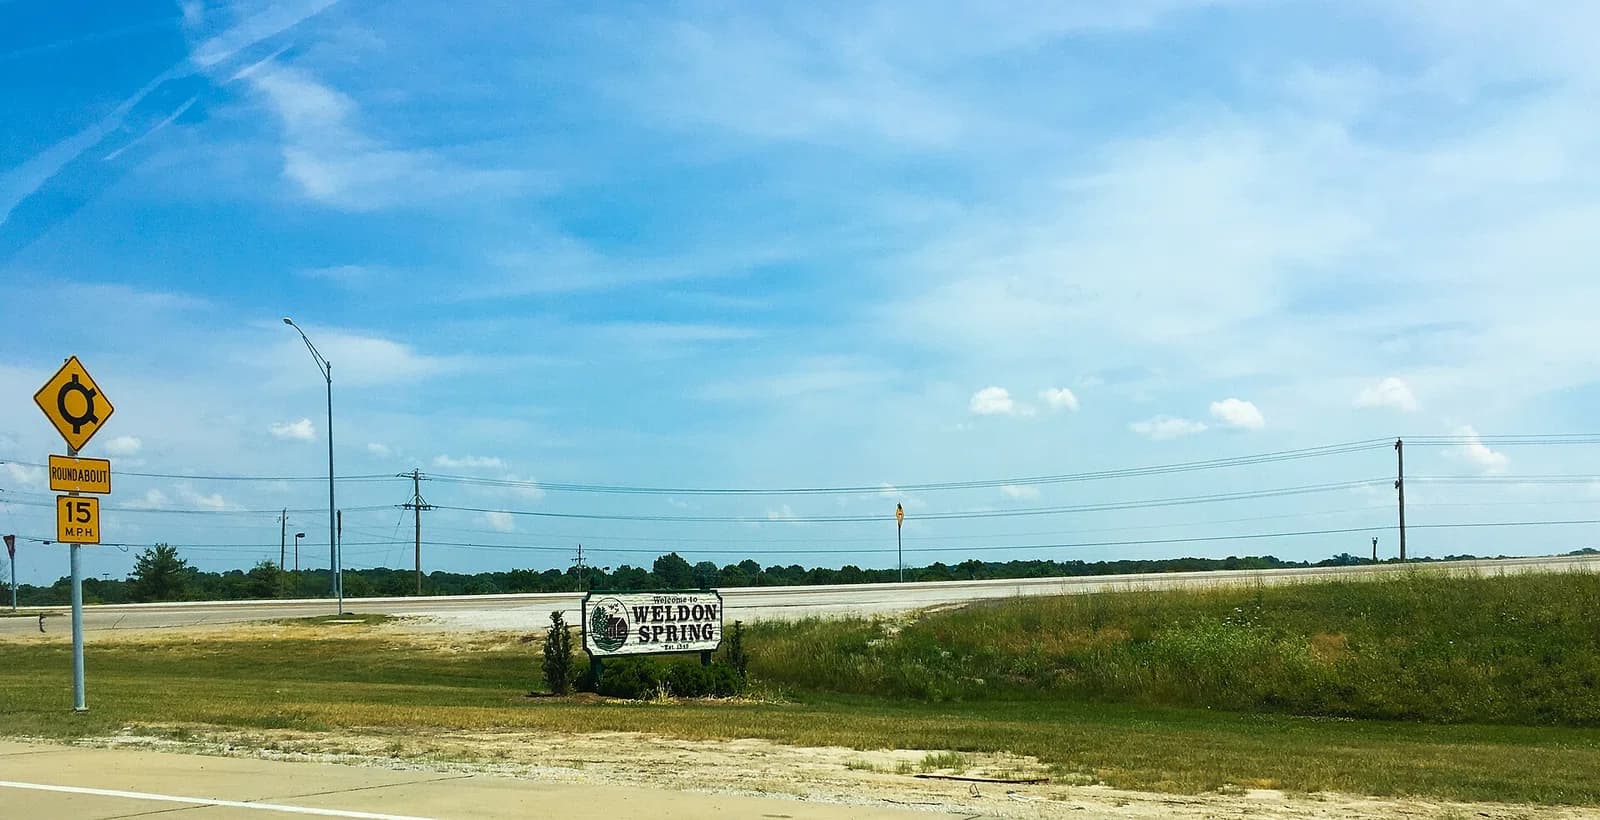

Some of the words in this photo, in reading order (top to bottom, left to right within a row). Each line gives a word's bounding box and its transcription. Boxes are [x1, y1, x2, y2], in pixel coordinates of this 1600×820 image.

[51, 466, 107, 483] ROUNDABOUT
[65, 501, 91, 523] 15
[653, 596, 687, 604] Welcome
[632, 604, 717, 623] WELDON
[639, 623, 714, 642] SPRING
